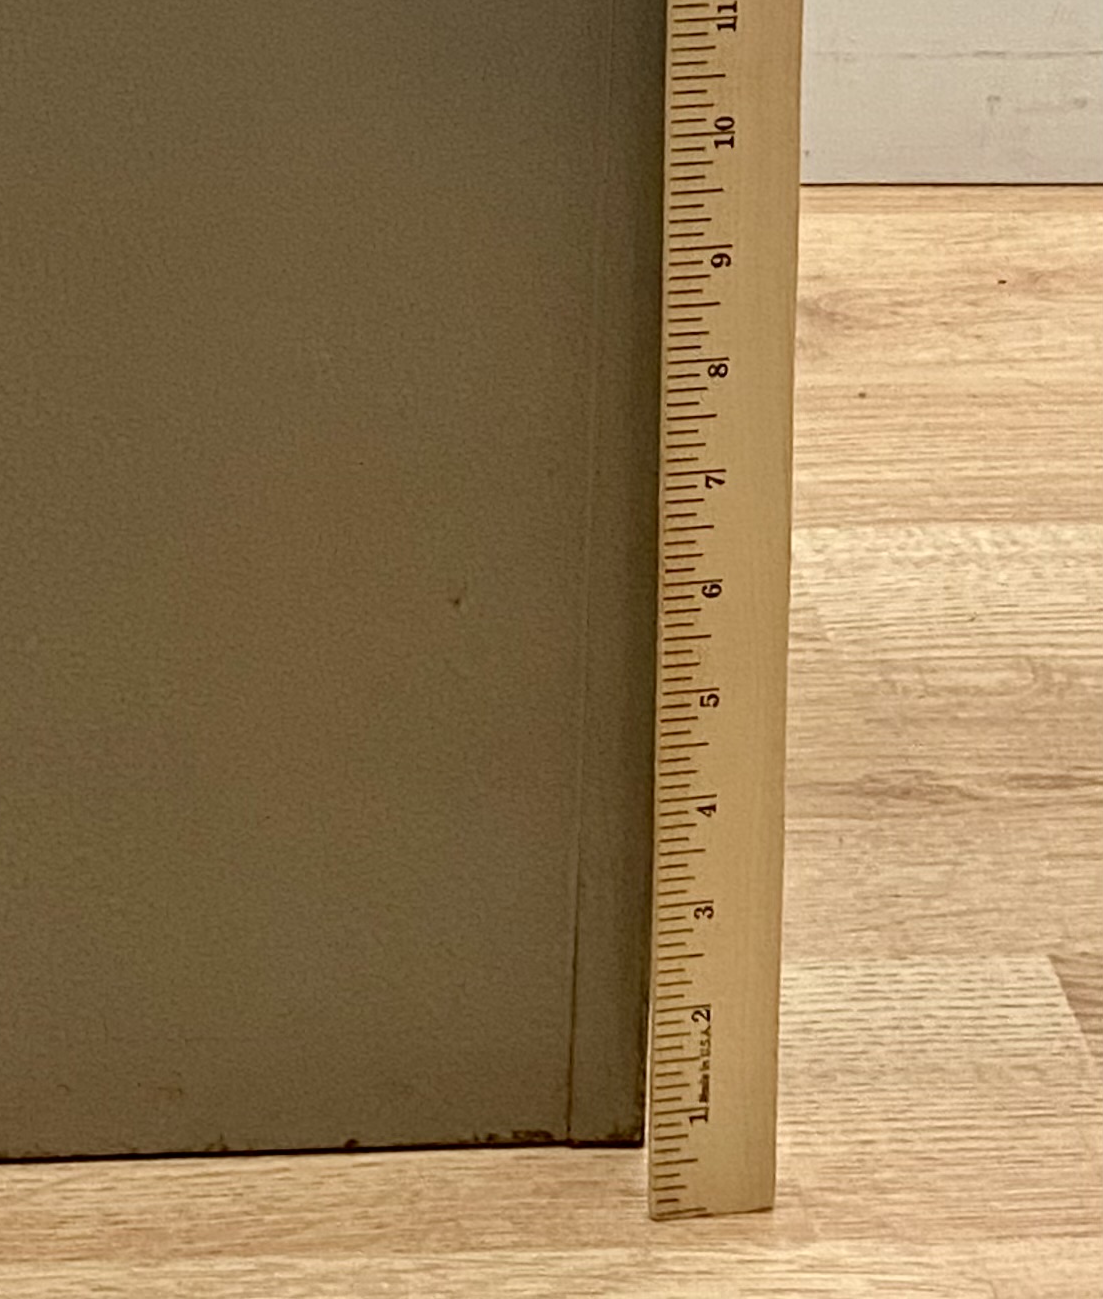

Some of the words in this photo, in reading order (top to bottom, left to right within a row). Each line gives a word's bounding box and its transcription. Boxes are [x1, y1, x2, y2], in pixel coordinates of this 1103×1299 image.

[717, 1, 738, 33] 11
[714, 116, 736, 150] 10
[709, 252, 732, 269] 9
[707, 362, 729, 379] 8
[705, 474, 727, 490] 7
[701, 582, 723, 598] 6
[699, 693, 720, 709] 5
[695, 804, 717, 818] 4
[693, 906, 715, 921] 3
[691, 1009, 712, 1023] 2
[689, 1108, 709, 1126] 1
